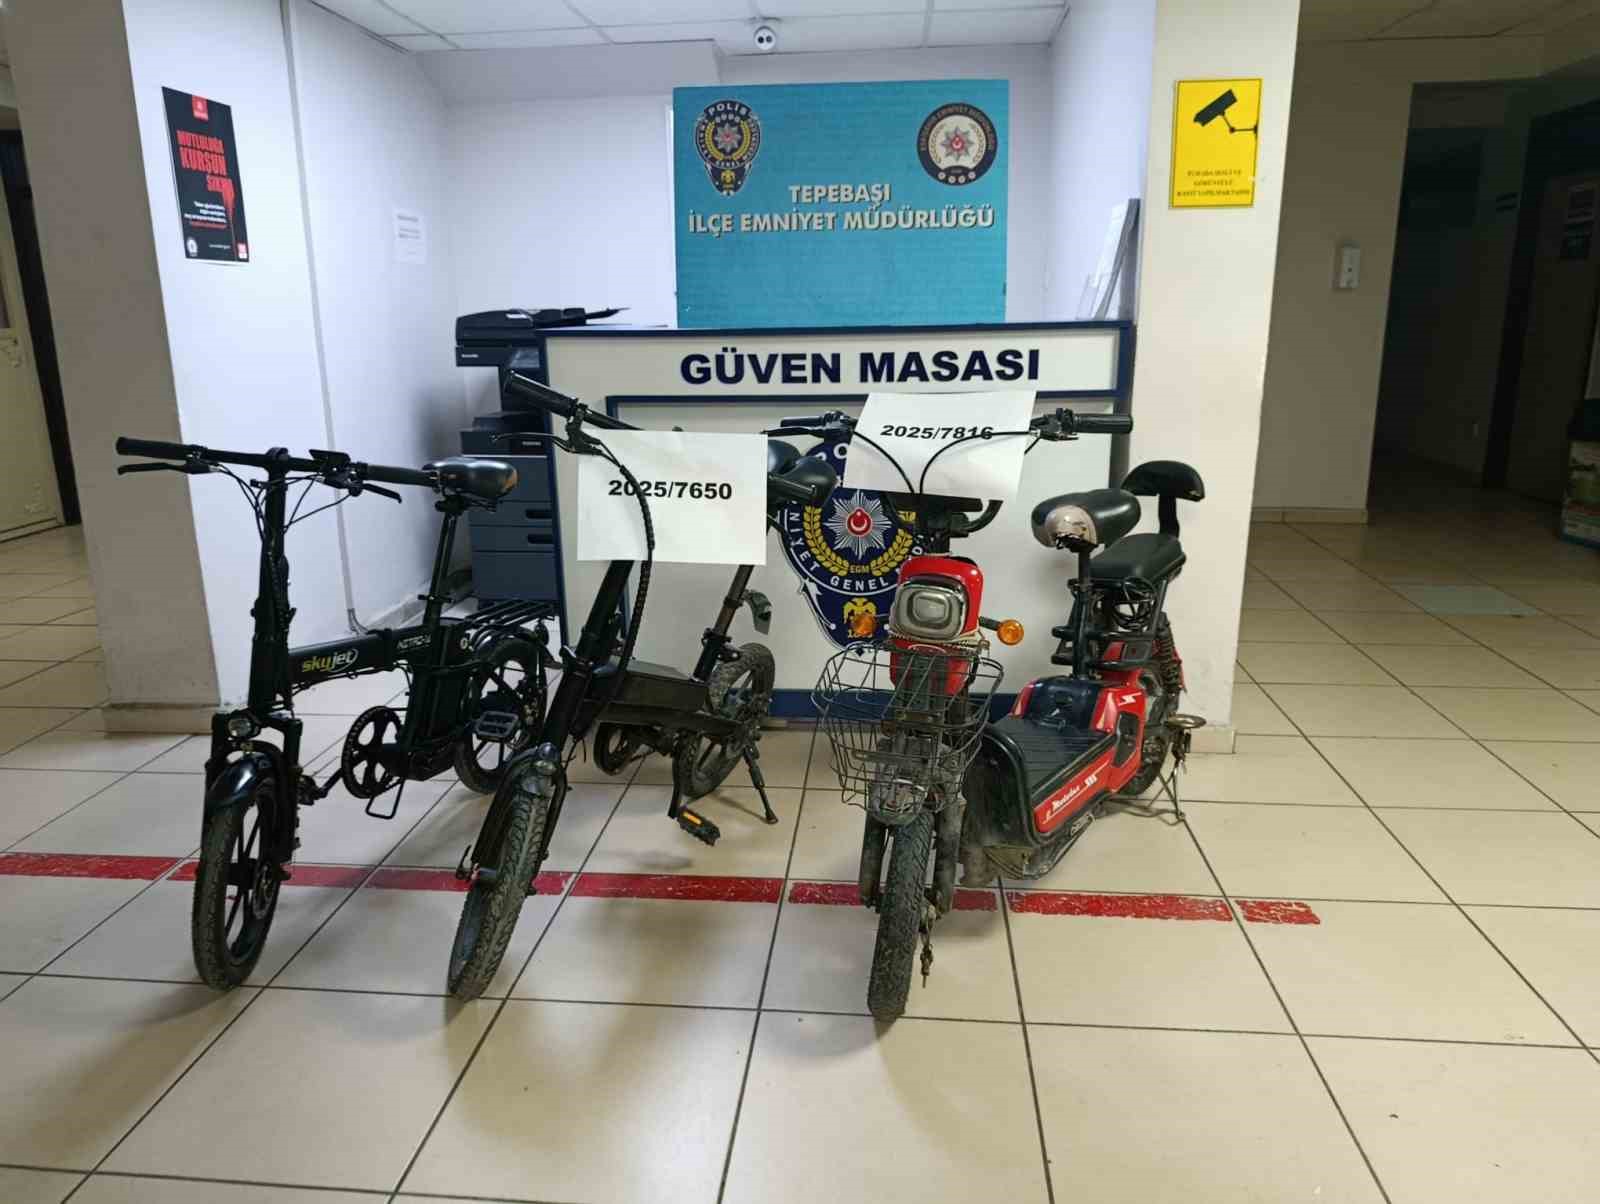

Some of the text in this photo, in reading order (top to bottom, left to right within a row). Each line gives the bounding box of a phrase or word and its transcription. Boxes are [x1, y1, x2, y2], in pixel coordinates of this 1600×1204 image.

[789, 183, 892, 207] TEPEBAŞI
[689, 204, 995, 239] İLÇE EMNİYET MÜDÜRLÜĞÜ
[680, 347, 1040, 385] GÜVEN MASASI
[879, 424, 995, 440] 2025/7816
[608, 479, 733, 500] 2025/7650
[849, 564, 870, 573] EGM
[829, 576, 889, 592] GENEL
[302, 649, 354, 673] skyjet
